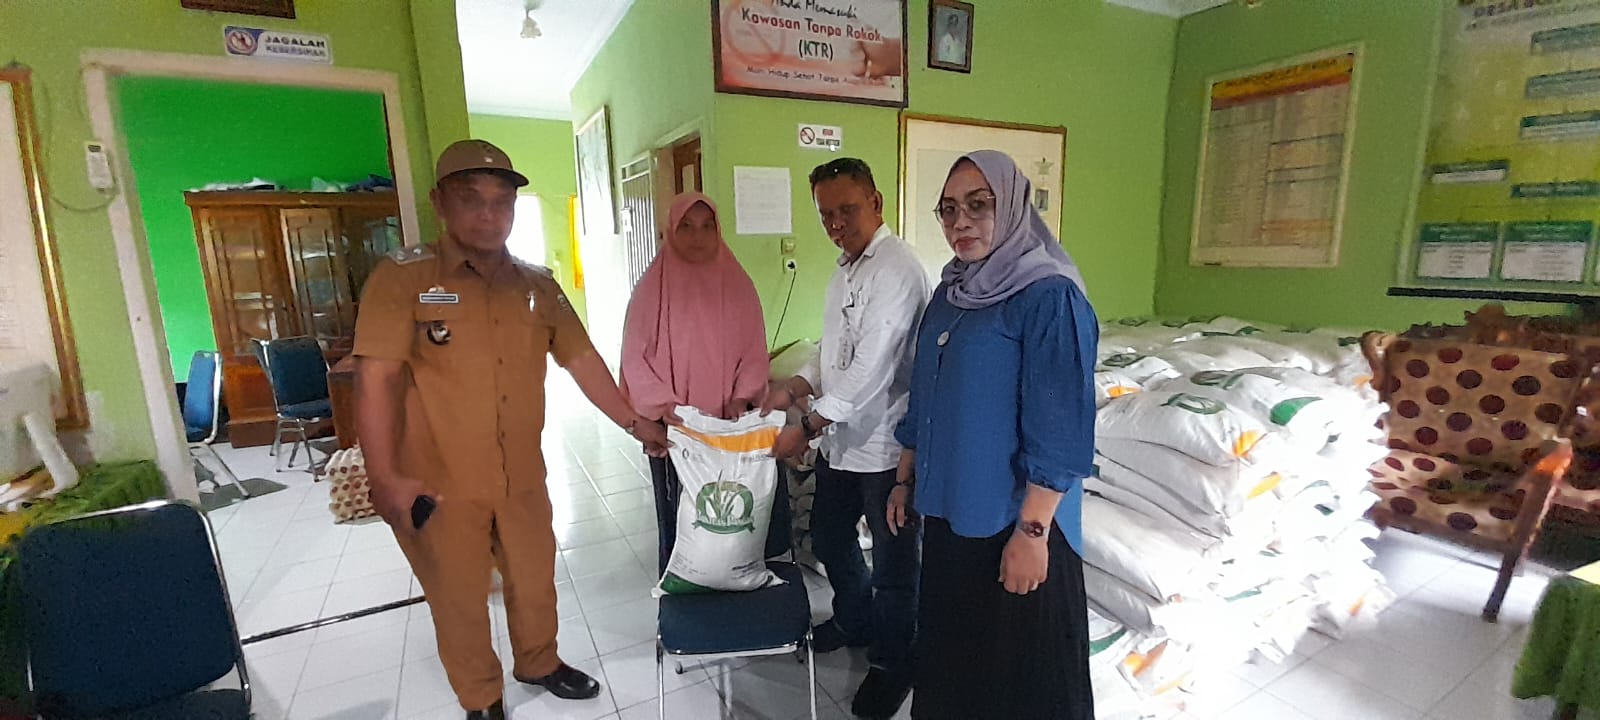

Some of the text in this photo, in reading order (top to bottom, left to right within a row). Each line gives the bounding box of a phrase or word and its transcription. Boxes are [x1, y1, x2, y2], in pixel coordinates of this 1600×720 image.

[742, 8, 882, 42] Kawasan Tanpa Rokok
[798, 39, 834, 62] (KTR)
